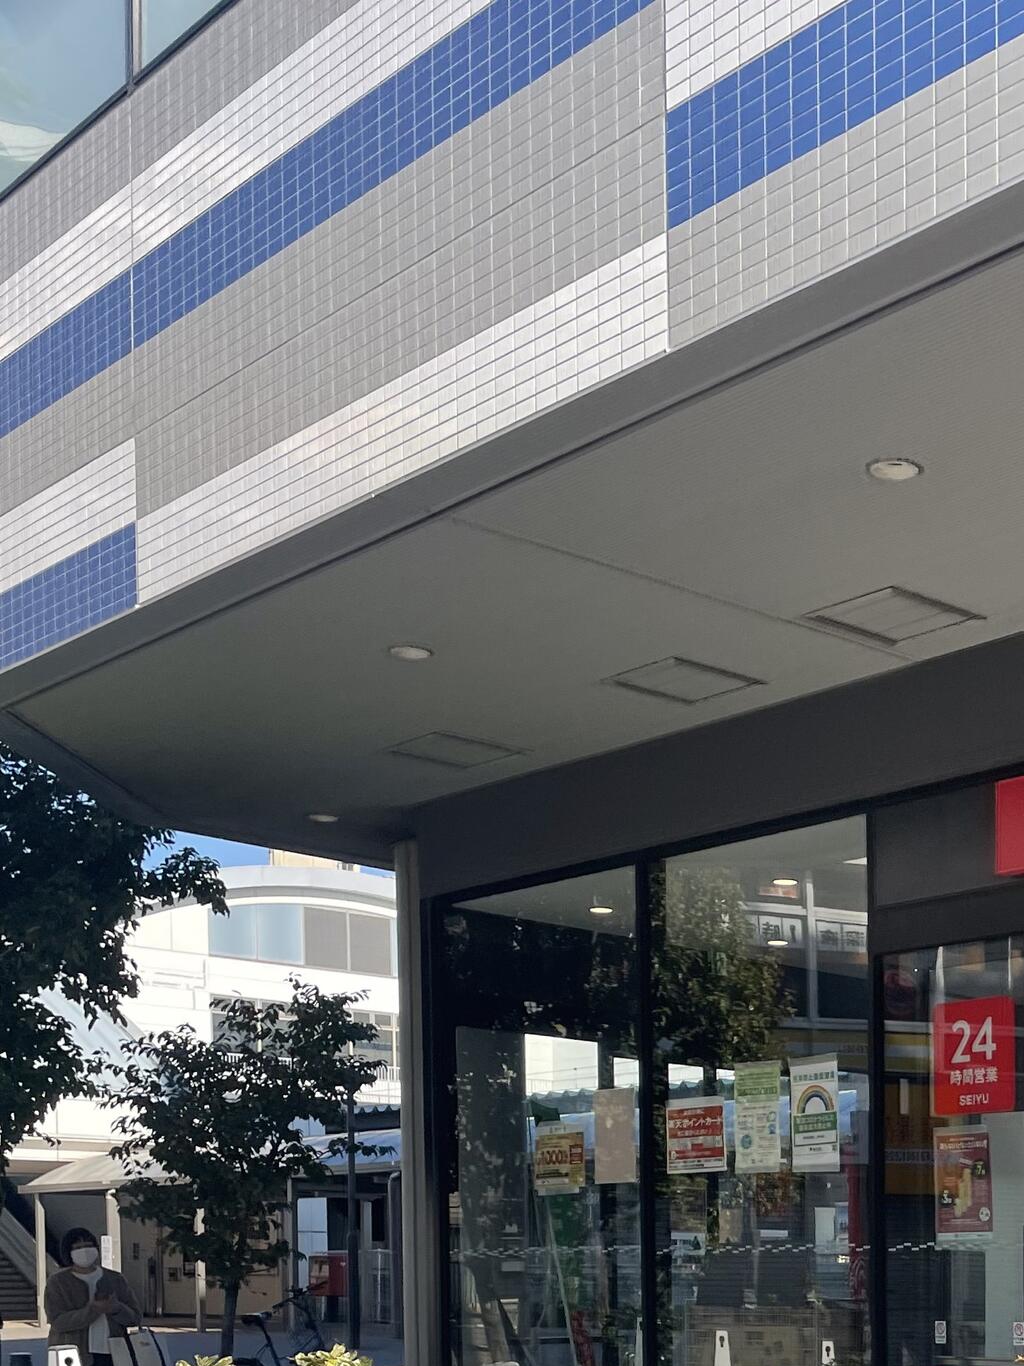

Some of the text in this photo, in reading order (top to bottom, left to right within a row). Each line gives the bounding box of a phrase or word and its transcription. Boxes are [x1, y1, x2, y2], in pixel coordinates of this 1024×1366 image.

[951, 1016, 996, 1064] 24
[949, 1066, 998, 1086] 時間営業
[959, 1093, 989, 1107] SEIYU
